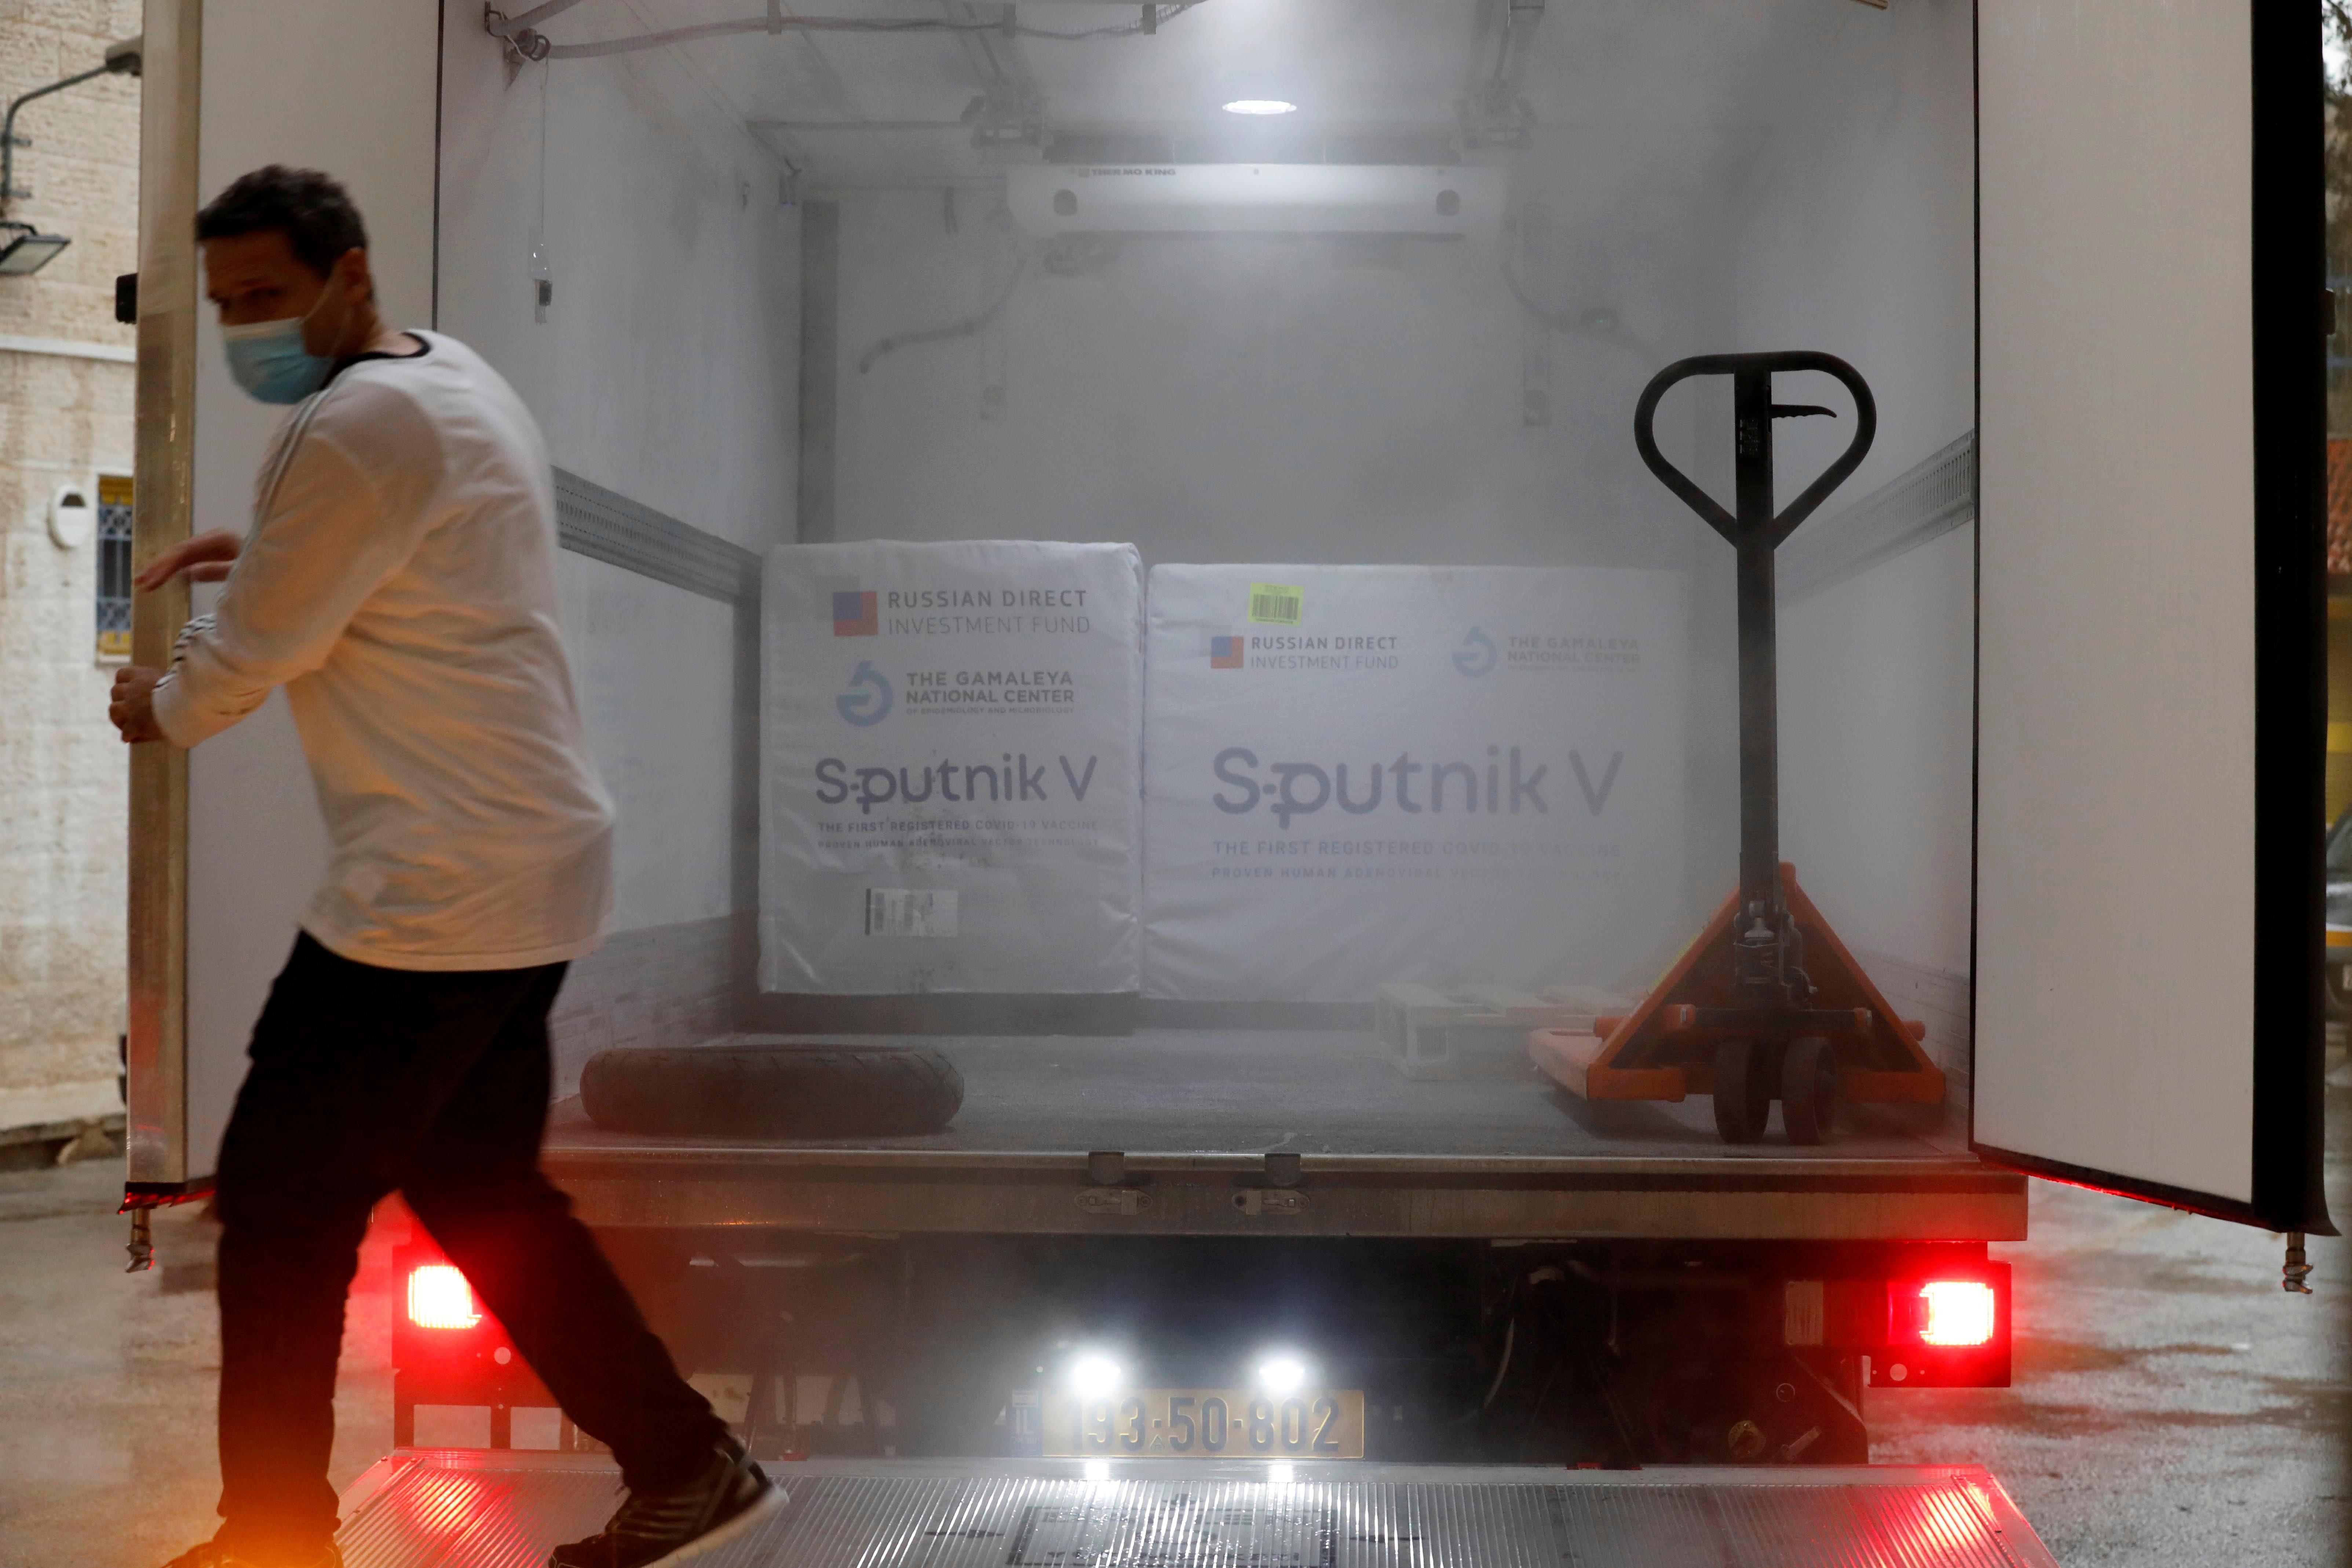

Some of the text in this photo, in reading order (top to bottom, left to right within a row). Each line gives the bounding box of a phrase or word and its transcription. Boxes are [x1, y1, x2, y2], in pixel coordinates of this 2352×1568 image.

[888, 589, 1087, 608] RUSSIAN DIRECT
[888, 615, 1091, 635] INVESTMENT FUND
[1252, 637, 1397, 650] RUSSIAN DIRECT
[1508, 636, 1640, 650] THE GAMALEYA
[1251, 655, 1399, 669] INVESTMENT FUND
[1507, 651, 1640, 664] NATIONAL CENTER
[906, 671, 1073, 686] THE GAMALEYA
[906, 689, 1075, 703] NATIONAL CENTER
[814, 752, 1099, 815] Sputnik V
[1212, 743, 1625, 831] Sputnik V
[817, 819, 1099, 833] THE FIRST REGISTERED COVID-19 VACCINE
[865, 839, 903, 848] HUMAN
[1212, 841, 1250, 855] THE
[1257, 840, 1311, 855] FIRST
[1318, 840, 1435, 856] REGISTERED
[1538, 843, 1621, 858] VACCINE
[1212, 867, 1273, 879] PROVEN
[1281, 867, 1337, 879] HUMAN
